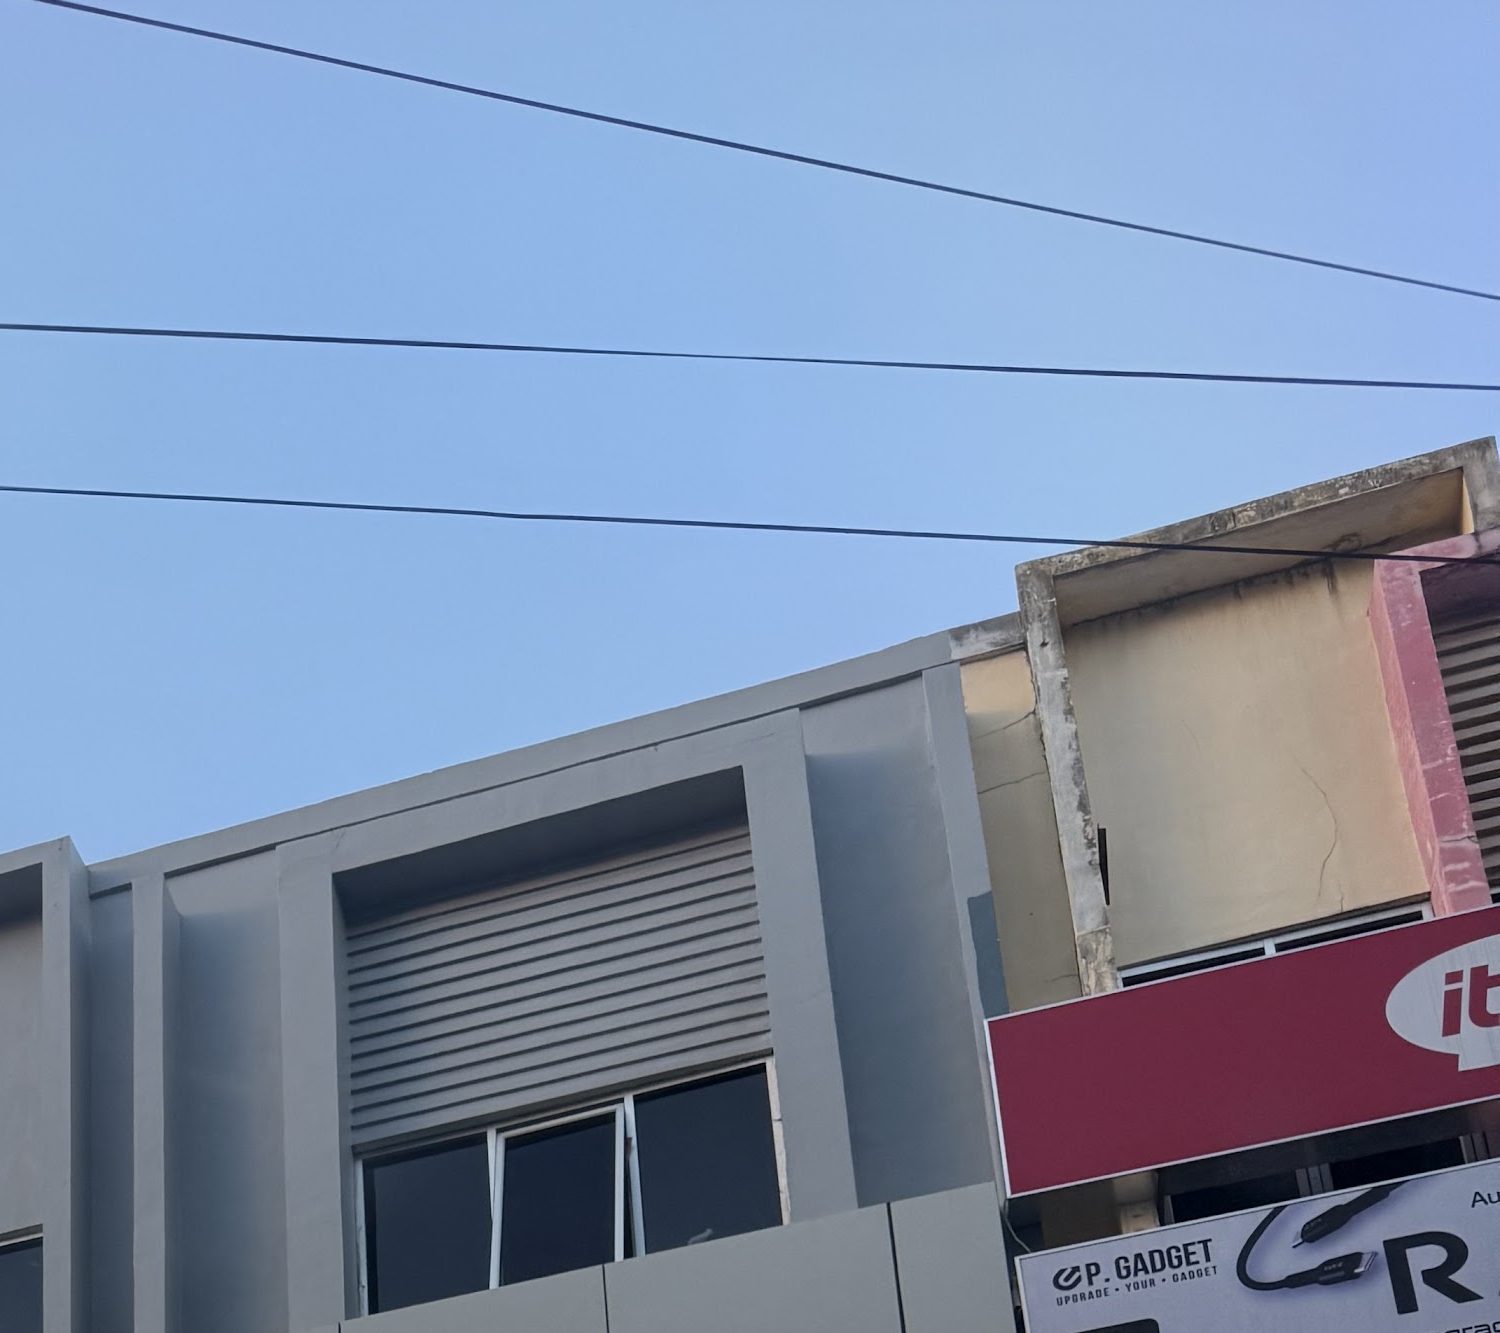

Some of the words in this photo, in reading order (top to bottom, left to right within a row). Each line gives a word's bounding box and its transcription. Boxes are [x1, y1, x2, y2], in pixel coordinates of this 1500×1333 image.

[1114, 1239, 1213, 1281] GADGET
[1055, 1286, 1110, 1306] UPGRADE
[1125, 1277, 1157, 1294] YOUR
[1171, 1264, 1219, 1284] GADGET
